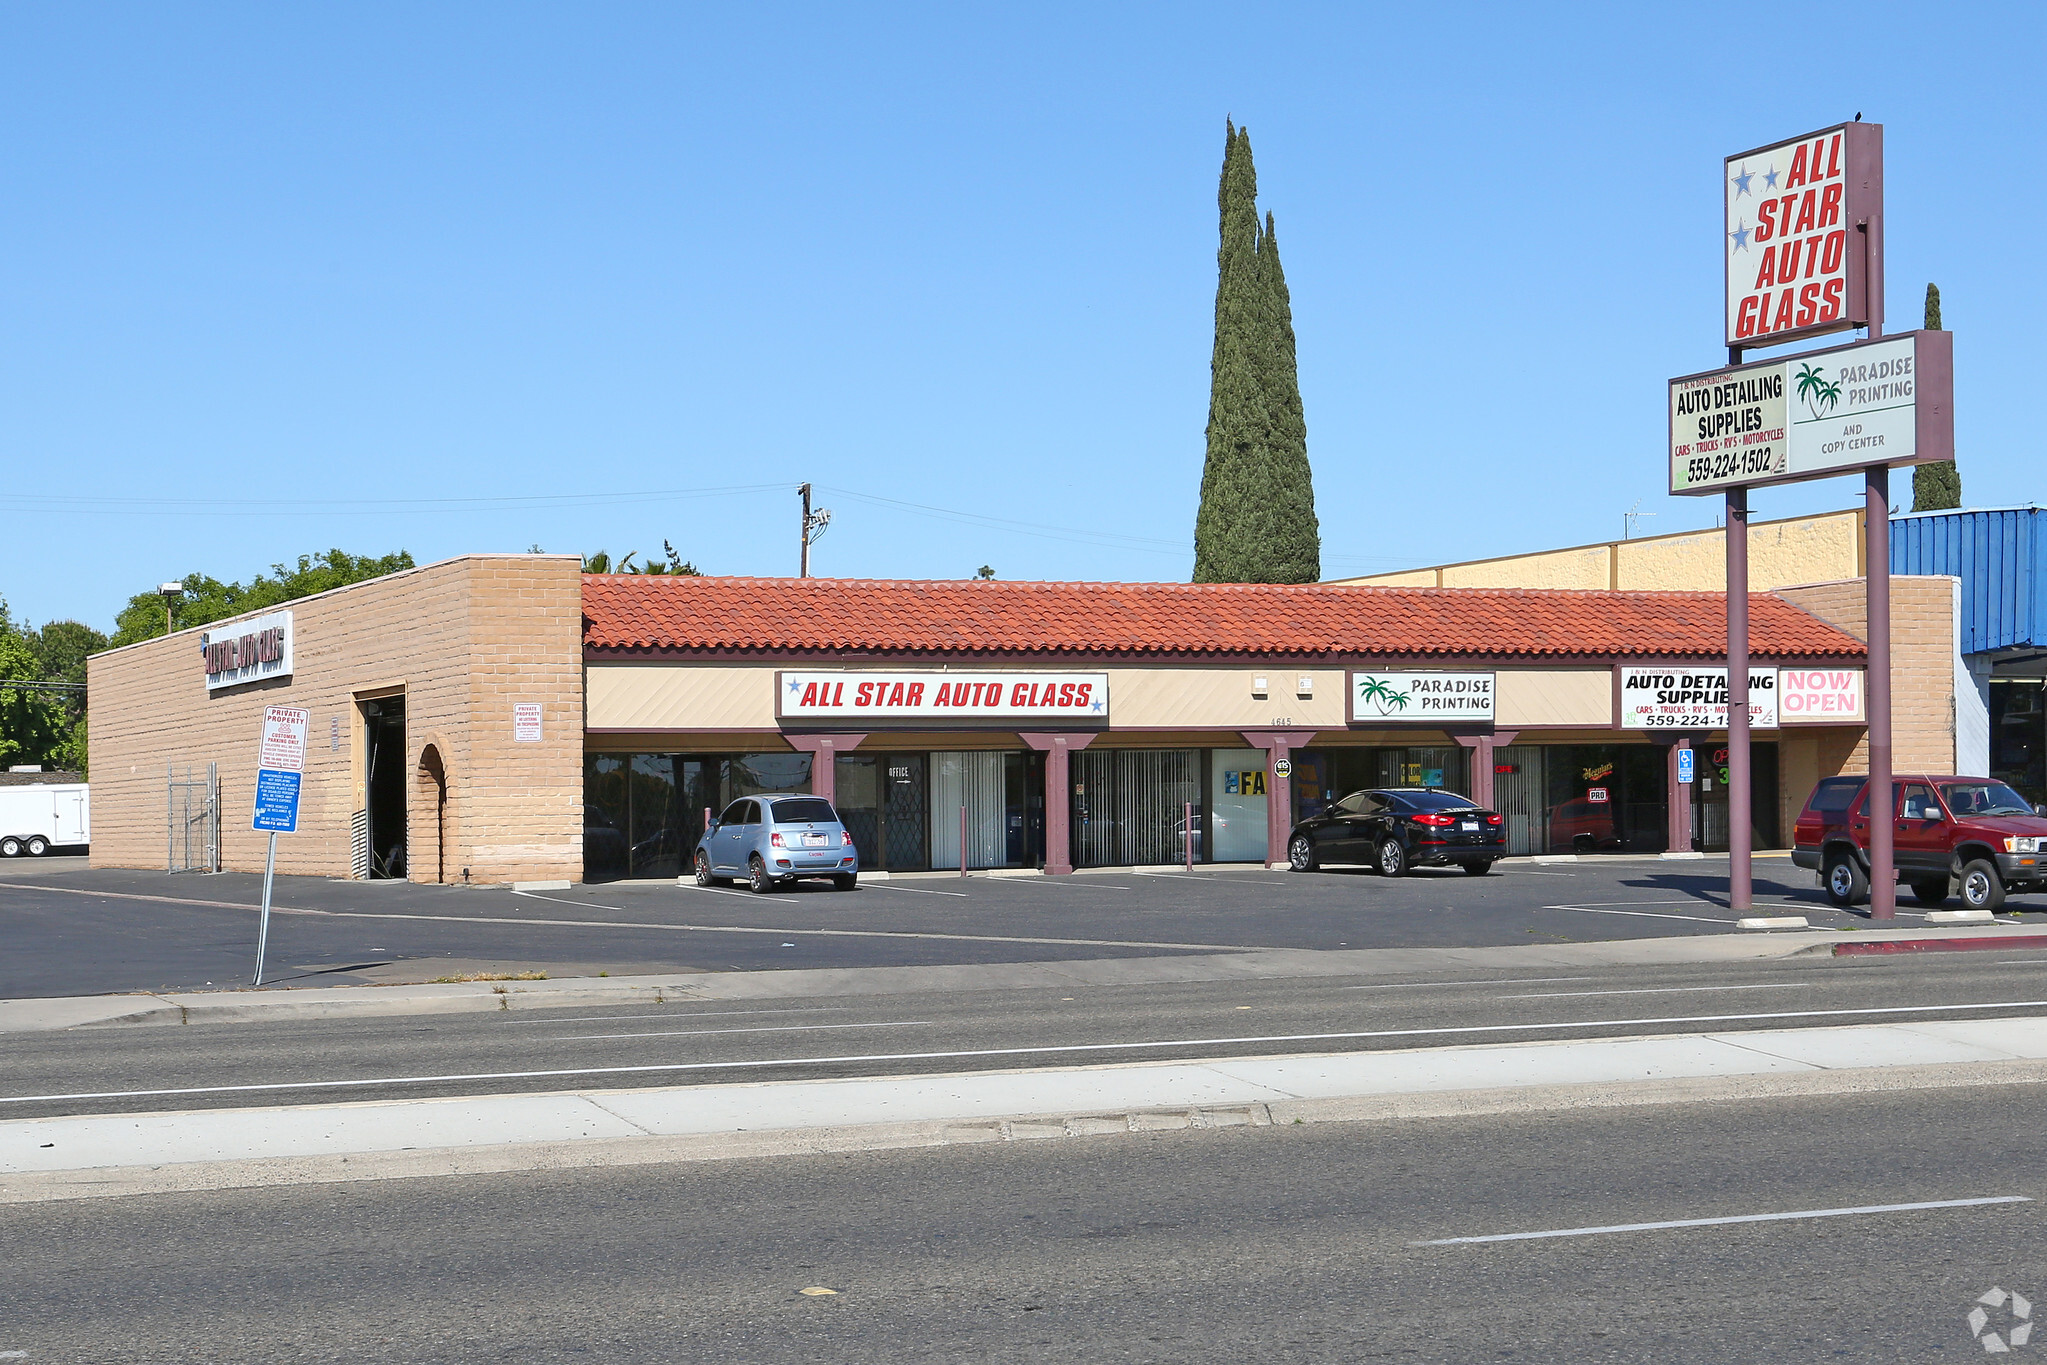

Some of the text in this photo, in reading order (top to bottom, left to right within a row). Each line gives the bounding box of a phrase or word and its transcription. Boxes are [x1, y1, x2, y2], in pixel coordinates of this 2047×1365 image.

[1786, 134, 1841, 189] ALL
[1754, 182, 1843, 242] STAR
[1754, 230, 1845, 290] AUTO
[1736, 278, 1844, 339] GLASS
[1696, 374, 1733, 388] DISTRIBUTING
[1840, 356, 1913, 386] PARADISE
[1677, 374, 1782, 416] AUTO DETAILING
[1849, 380, 1913, 406] PRINTING
[1698, 406, 1762, 440] SUPPLIES
[1843, 424, 1862, 436] AND
[1675, 428, 1784, 456] CARS TRUCKS RV'S MOTORCYCLES
[1822, 434, 1885, 454] COPY CENTER
[1688, 446, 1770, 482] 559-224-1502
[1412, 680, 1491, 693] PARADISE
[1626, 675, 1773, 689] AUTO DETANG
[1787, 672, 1854, 690] NOW
[800, 682, 1092, 707] ALL STAR AUTO GLASS
[1422, 697, 1490, 709] PRINTING
[1657, 690, 1728, 704] SUPPLIE
[1784, 694, 1855, 712] OPEN
[268, 716, 304, 724] PROPERTY
[272, 709, 301, 718] PRIVATE
[1271, 718, 1292, 726] 4645
[889, 767, 908, 777] OFFICE
[1242, 772, 1267, 794] FA
